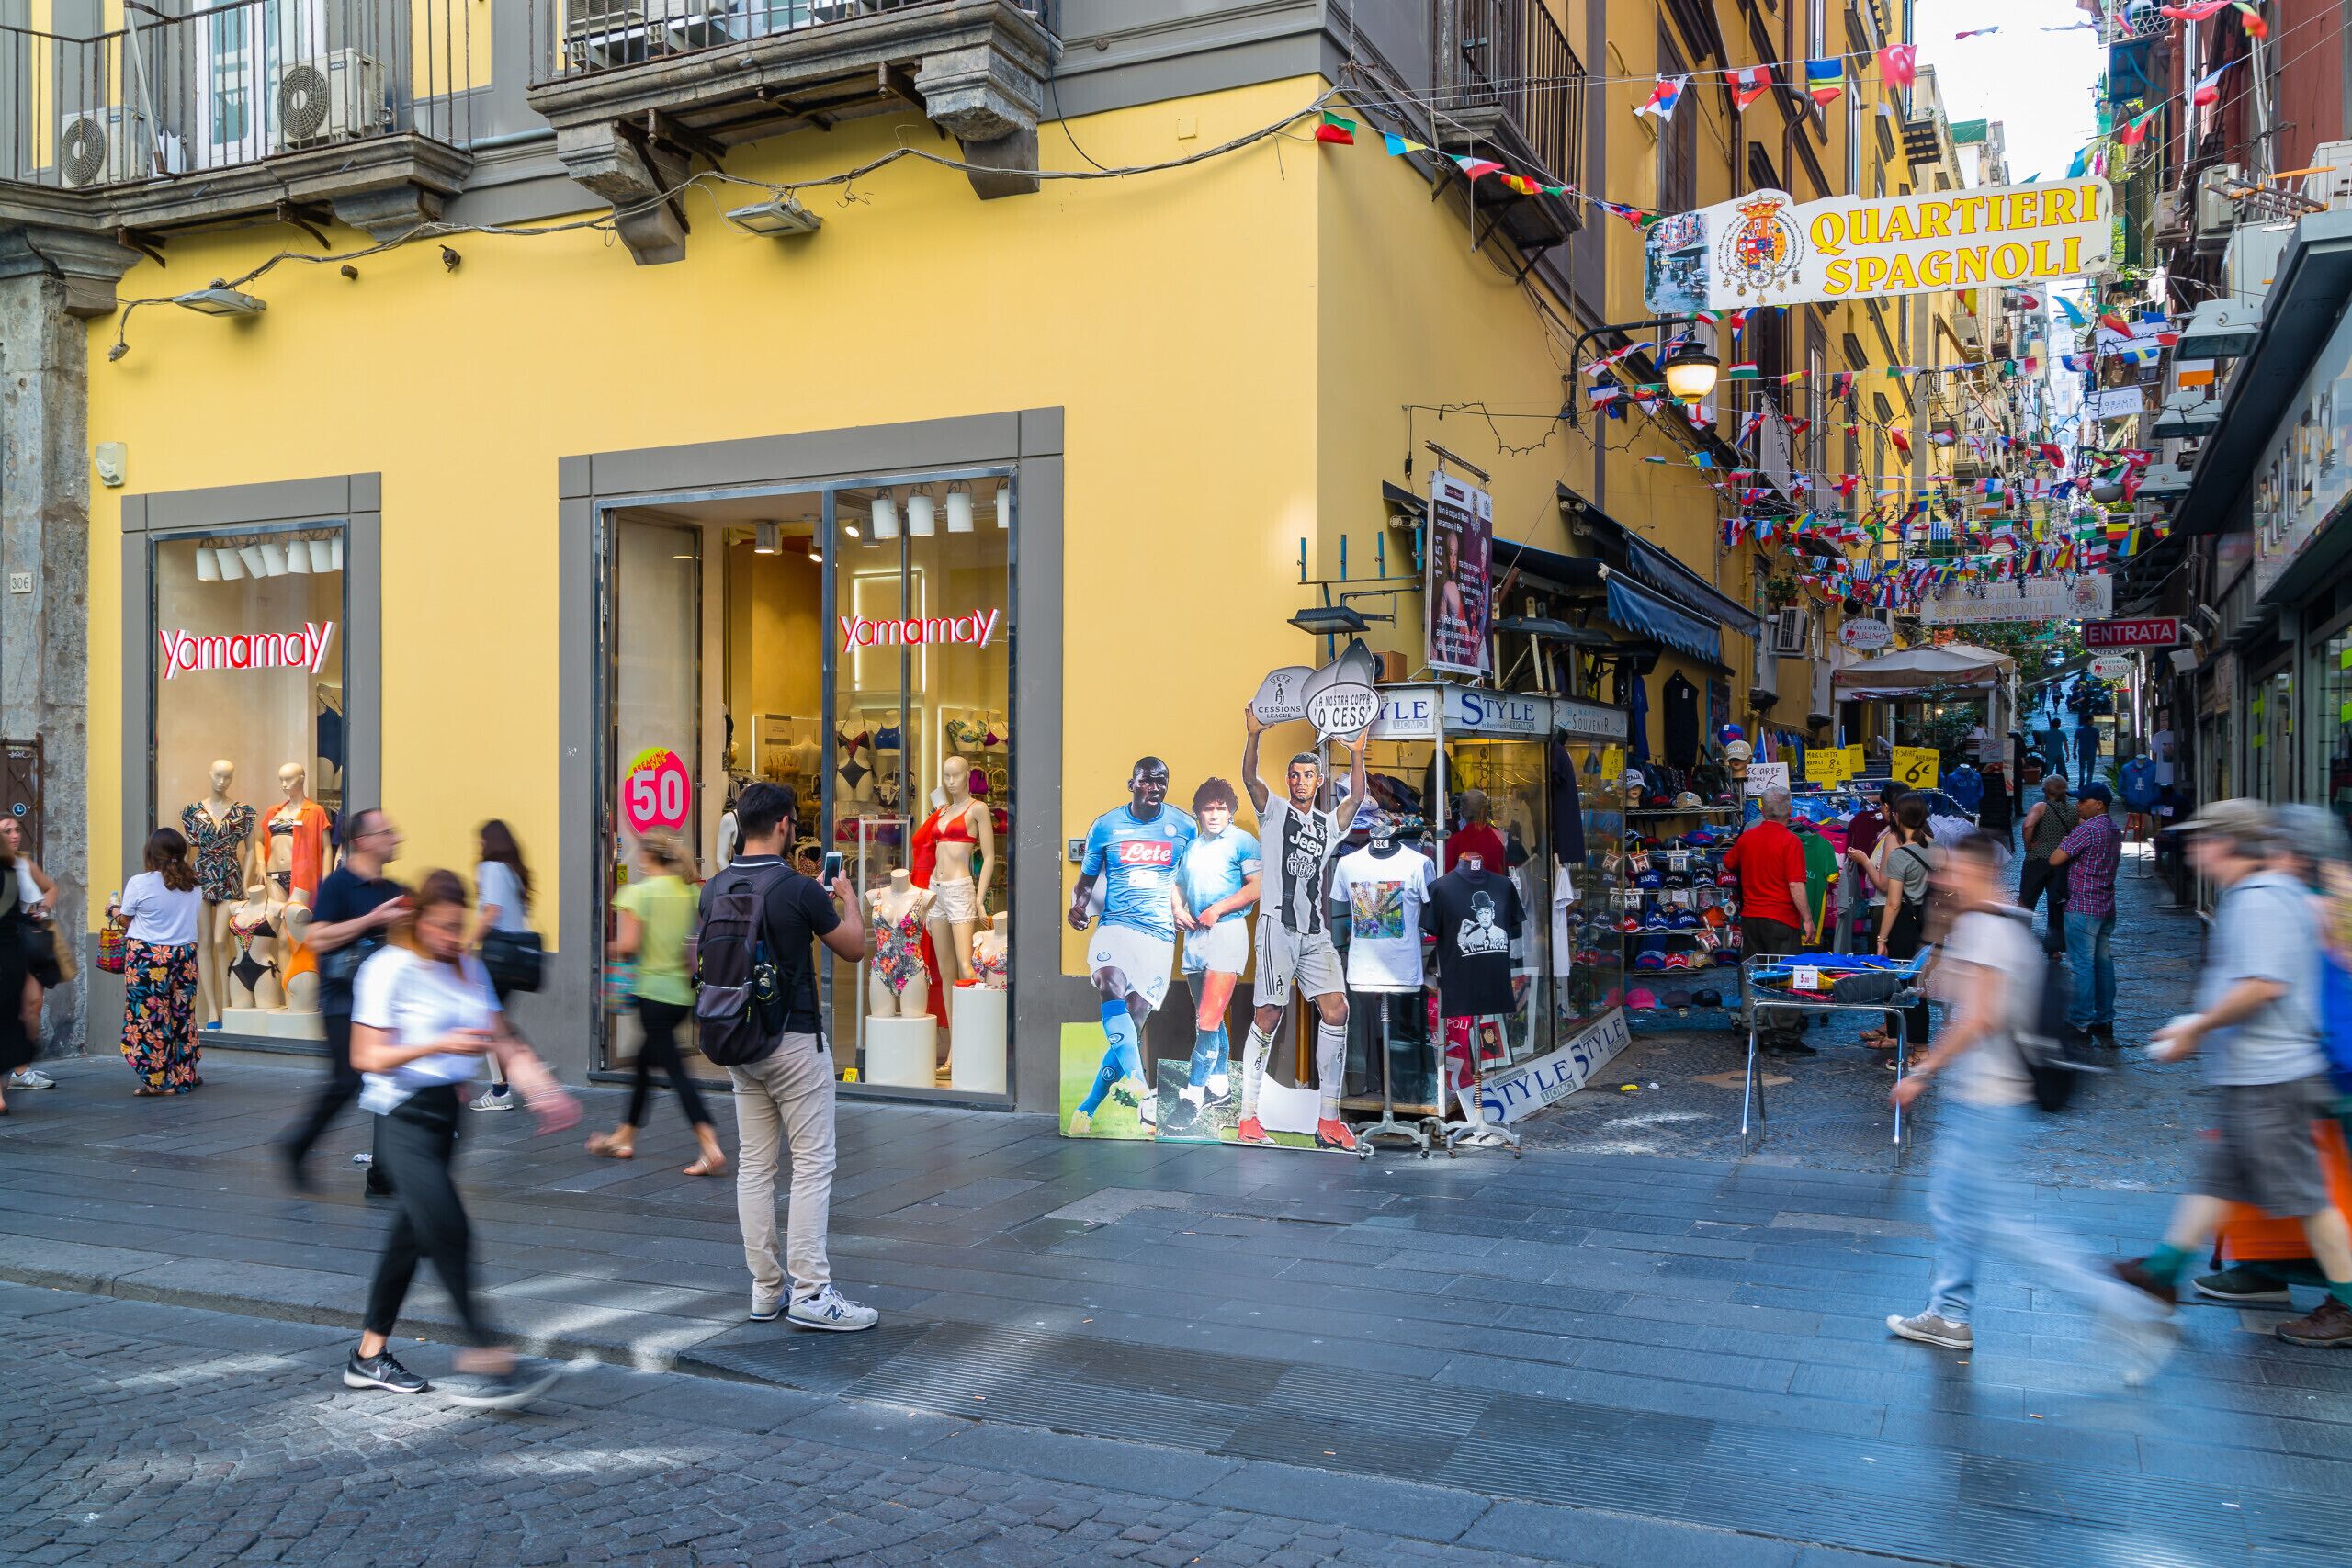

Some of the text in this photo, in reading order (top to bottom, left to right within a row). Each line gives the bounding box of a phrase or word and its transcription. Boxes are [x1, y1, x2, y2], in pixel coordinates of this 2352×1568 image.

[1809, 184, 2099, 256] QUARTIERI
[1823, 236, 2081, 295] SPAGNOLI
[1434, 535, 1442, 578] 1751
[11, 576, 29, 589] 306
[1934, 600, 2052, 618] SPAGNOLI
[2088, 623, 2174, 643] ENTRATA
[1269, 674, 1293, 685] UEFA
[1315, 696, 1324, 706] LA
[1325, 694, 1349, 706] NOSTRA
[1350, 693, 1373, 705] COPPA:
[1258, 705, 1301, 714] CESSIONS
[1378, 701, 1430, 720] YLE
[1461, 693, 1535, 726] STYLE
[1395, 720, 1426, 729] UOMO
[1511, 721, 1534, 731] UOMO
[1572, 713, 1610, 734] SOUVENIR
[632, 750, 666, 774] BREAKING
[650, 757, 668, 771] DAYS
[1747, 767, 1781, 776] SCIARPE
[632, 769, 684, 821] 50
[1120, 842, 1172, 862] Lete
[1289, 830, 1323, 857] Jeep
[1375, 840, 1386, 848] 8€
[1640, 874, 1658, 883] NAPOLI
[1679, 914, 1697, 924] ITALIA
[1458, 942, 1470, 953] E
[1570, 1017, 1625, 1079] STYLE
[1473, 1059, 1573, 1122] STYLE
[1543, 1081, 1575, 1101] UOMO
